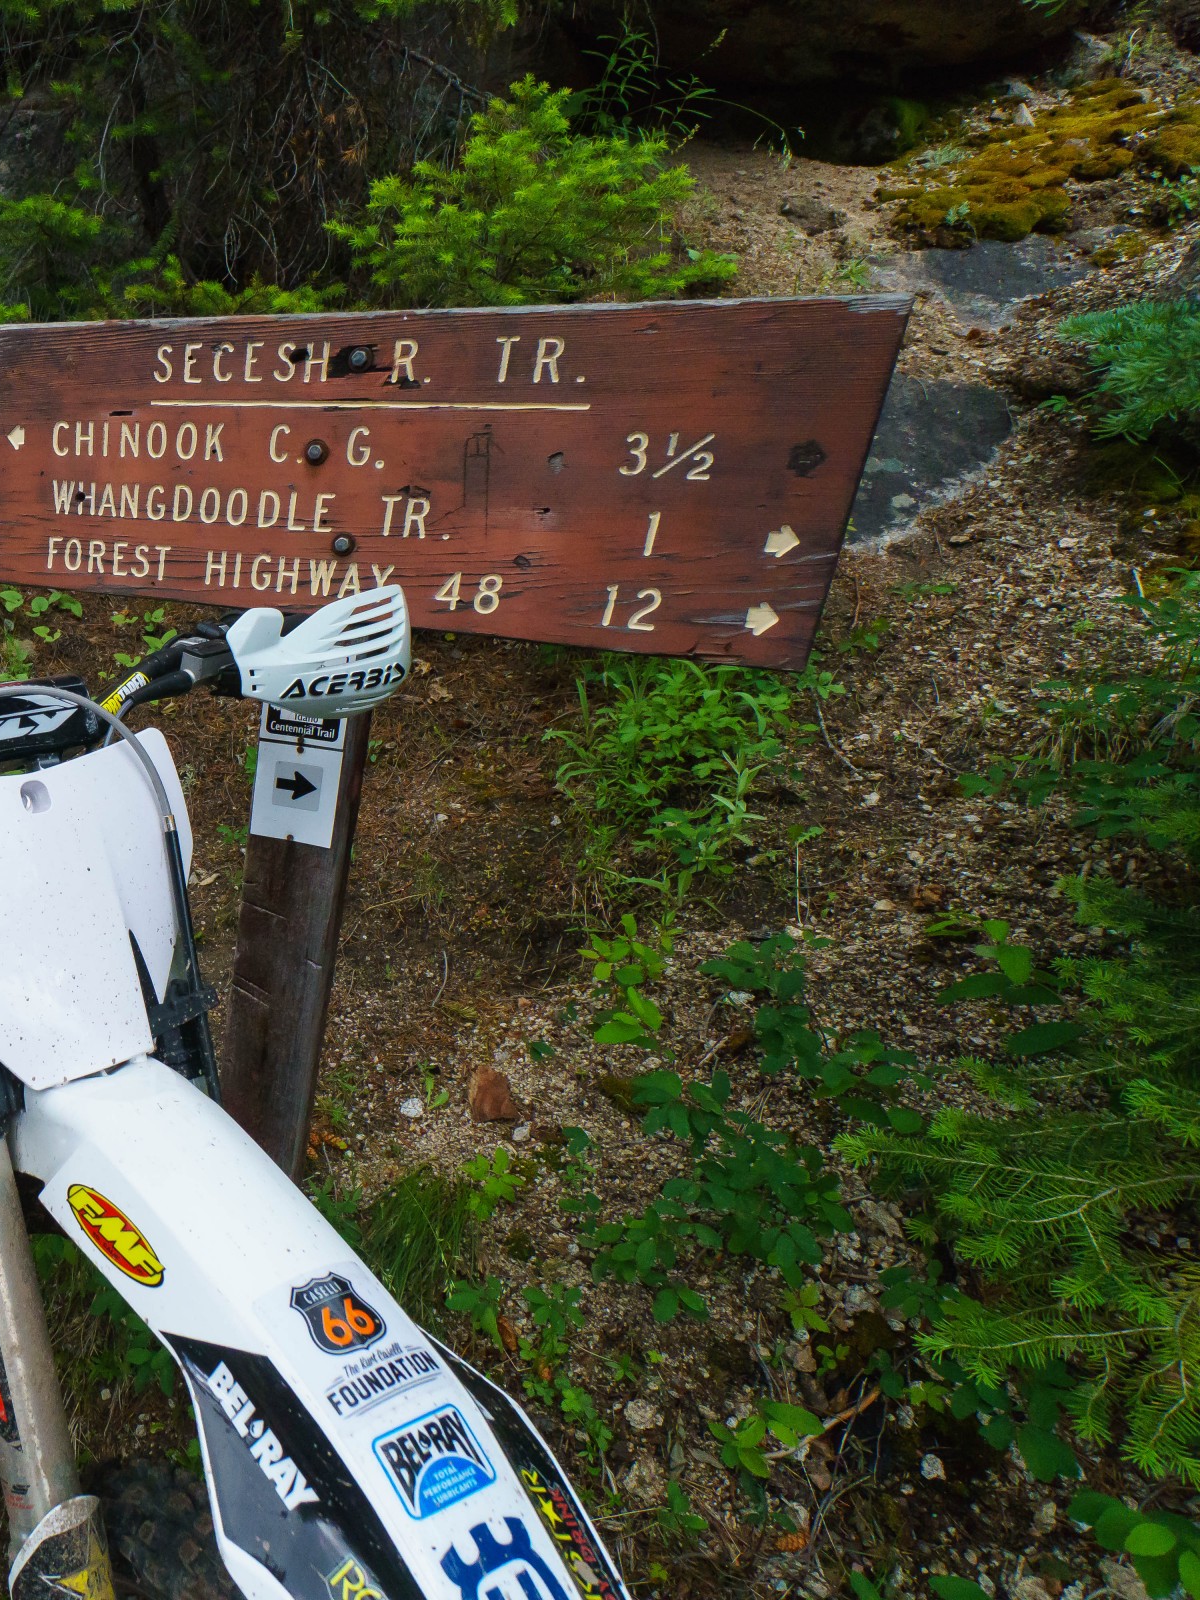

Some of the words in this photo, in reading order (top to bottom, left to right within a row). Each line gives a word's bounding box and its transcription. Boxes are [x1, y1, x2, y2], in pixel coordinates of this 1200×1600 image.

[153, 340, 330, 383] SECESH
[390, 338, 431, 384] R.
[52, 421, 225, 462] CHINOOK
[269, 423, 303, 464] C.
[346, 425, 386, 469] G.
[52, 480, 336, 533] WHANGDOODLE
[381, 494, 451, 540] TR.
[643, 511, 661, 556] 1
[47, 537, 171, 580] FOREST
[204, 550, 395, 599] HIGHWAY
[435, 571, 503, 614] 48
[602, 585, 662, 631] 12
[279, 662, 405, 698] ACERBIS
[270, 721, 314, 735] Centennial
[317, 726, 335, 739] Trail
[67, 1187, 165, 1277] FMF
[302, 1281, 342, 1304] CASELLI
[321, 1297, 375, 1346] 66
[327, 1351, 440, 1416] FOUNDATION
[343, 1363, 360, 1378] The
[377, 1342, 404, 1365] Caselli
[433, 1462, 458, 1482] TOTAL
